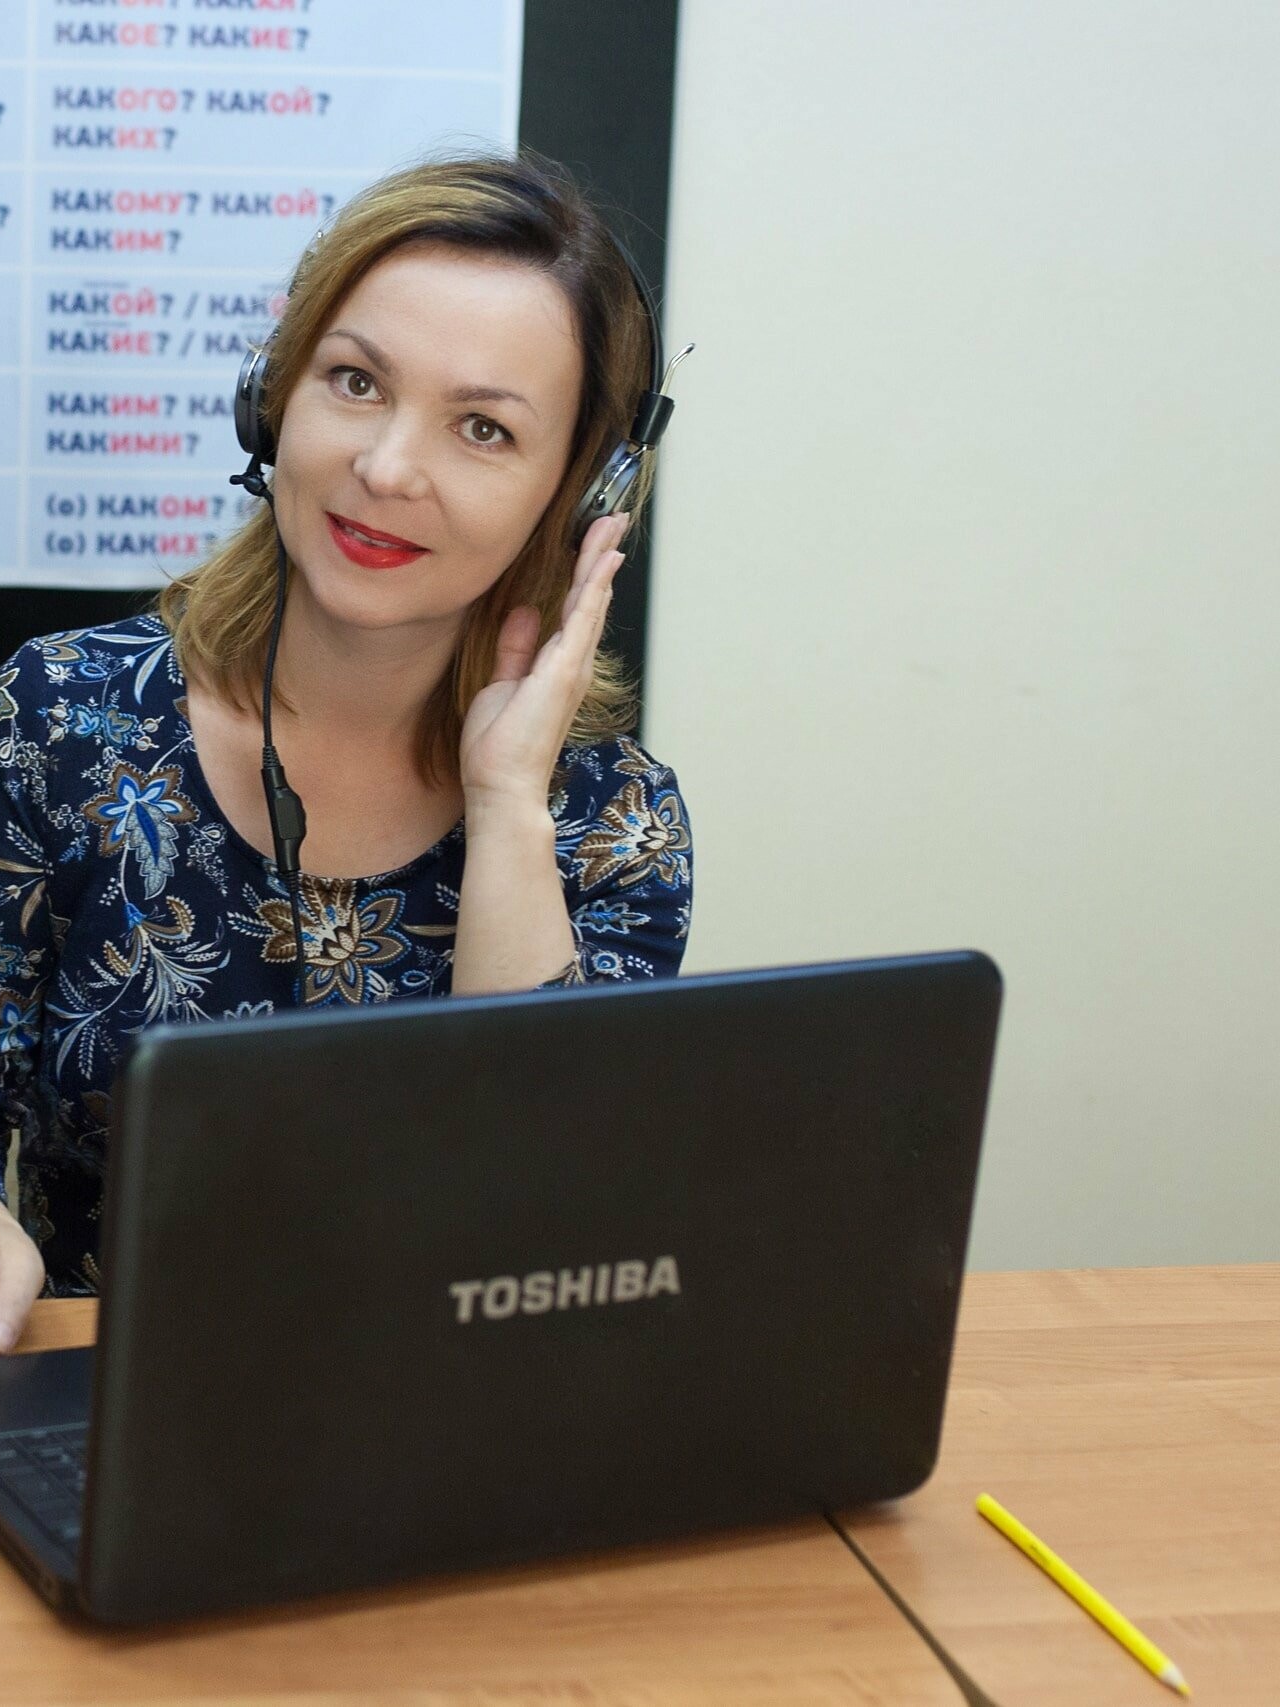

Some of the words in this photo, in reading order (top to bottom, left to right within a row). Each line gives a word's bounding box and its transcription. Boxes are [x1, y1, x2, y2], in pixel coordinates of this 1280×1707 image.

[55, 23, 177, 47] КАКОЕ?
[188, 26, 310, 49] КАКИЕ?
[53, 87, 196, 112] КАКОГО?
[207, 85, 331, 117] КАКОЙ?
[53, 126, 176, 151] КАКИХ?
[52, 191, 200, 216] КАКОМУ?
[212, 187, 334, 218] КАКОЙ?
[51, 228, 181, 254] КАКИМ?
[48, 287, 175, 317] КАКОЙ?
[48, 331, 171, 355] КАКИЕ?
[48, 393, 178, 417] КАКИМ?
[47, 432, 200, 456] КАКИМИ?
[46, 495, 86, 519] (о)
[97, 495, 225, 519] КАКОМ?
[45, 532, 85, 556] (о)
[448, 1255, 682, 1325] TOSHIBA
